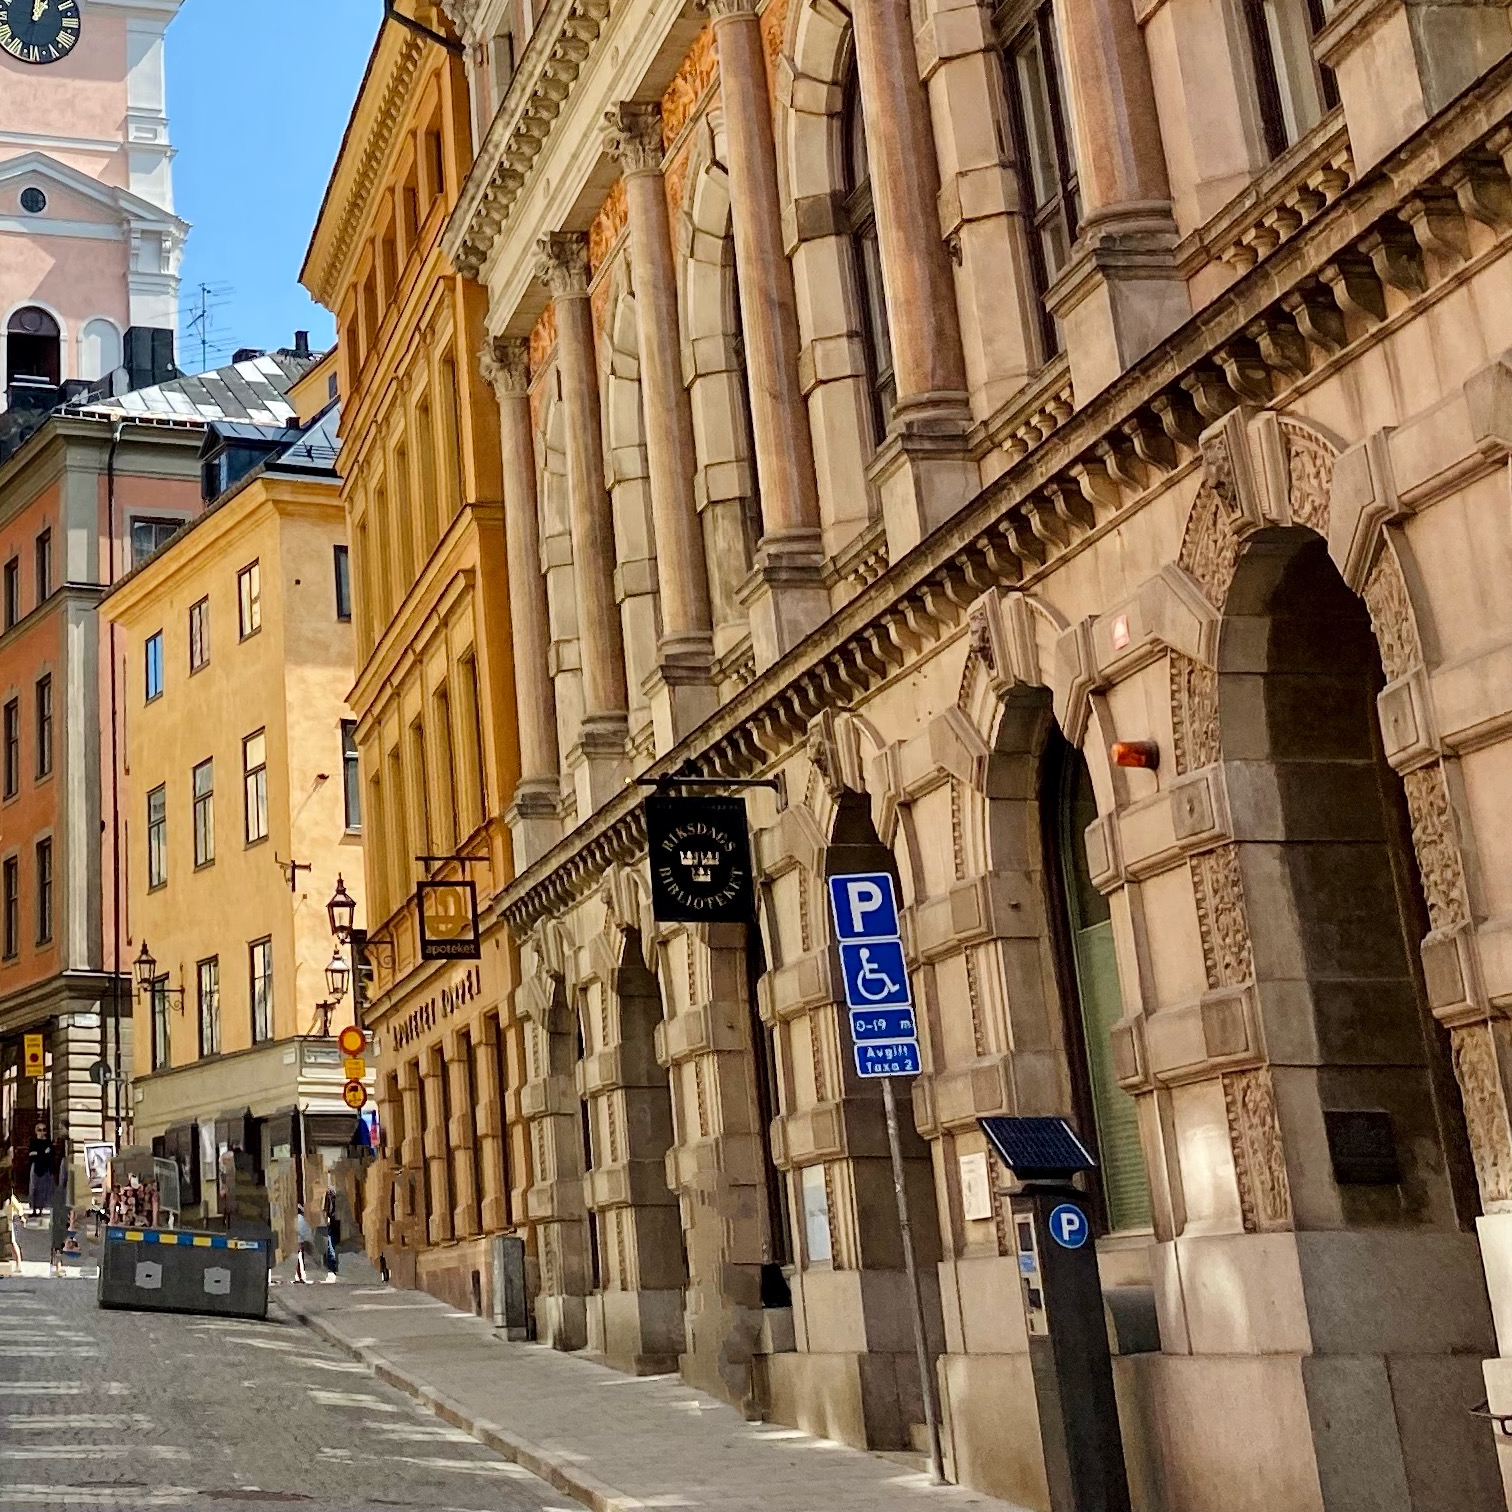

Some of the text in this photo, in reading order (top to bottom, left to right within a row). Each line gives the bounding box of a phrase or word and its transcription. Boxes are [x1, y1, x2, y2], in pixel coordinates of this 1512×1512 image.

[58, 0, 74, 11] II
[62, 18, 79, 28] III
[48, 43, 60, 59] V
[662, 823, 736, 852] RIKSDAGS
[659, 867, 743, 909] BIBLIOTEKET
[846, 881, 883, 932] P
[425, 943, 476, 956] apoteket
[866, 1059, 913, 1073] Taxa 2
[1060, 1212, 1080, 1241] P
